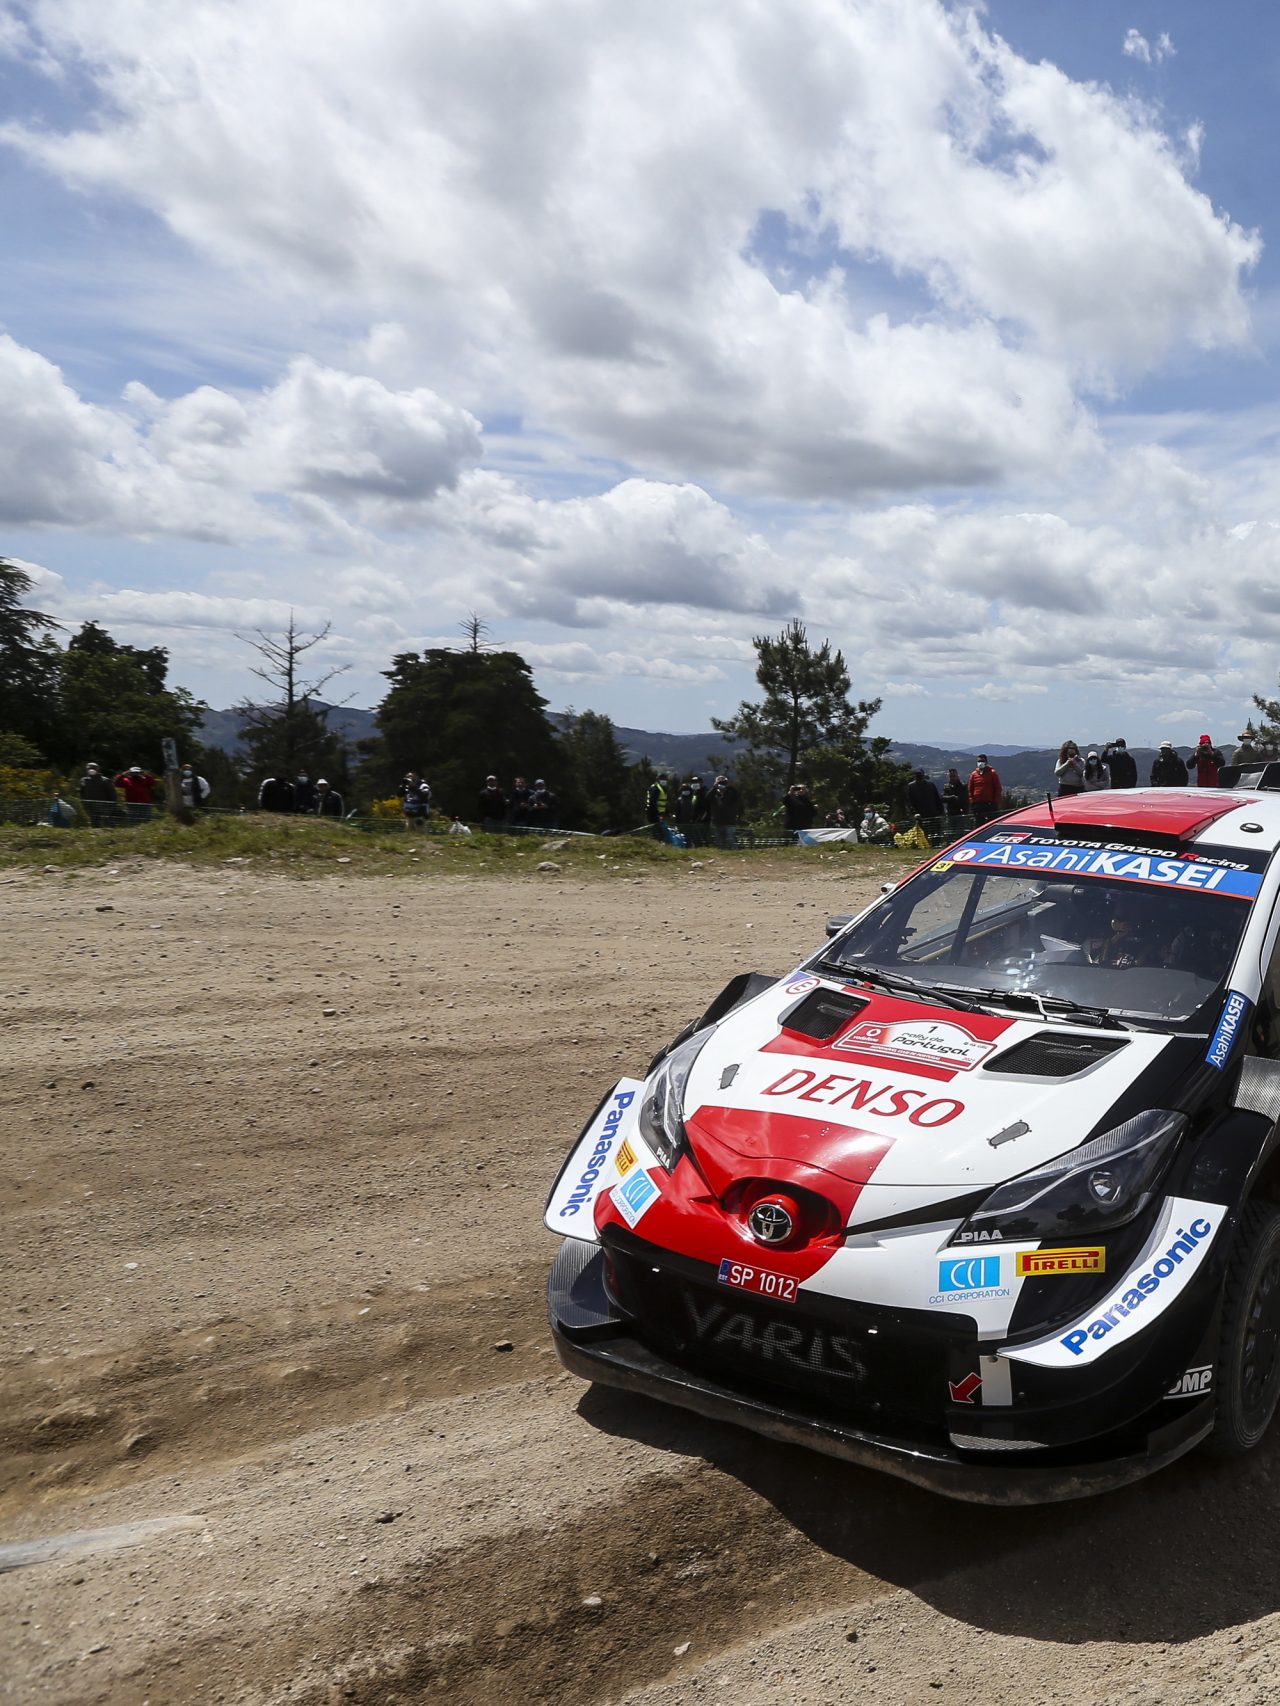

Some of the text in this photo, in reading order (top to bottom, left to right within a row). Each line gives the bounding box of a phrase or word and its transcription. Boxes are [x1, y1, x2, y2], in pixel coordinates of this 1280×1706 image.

[978, 845, 1228, 889] AsahiKASEI
[1029, 837, 1250, 870] TOYOTA GAZOO Racing
[901, 1032, 929, 1041] rally
[928, 1025, 939, 1034] 1
[1210, 995, 1245, 1068] AsahiKASEI
[891, 1036, 970, 1057] Portugal
[760, 1068, 966, 1128] DENSO
[559, 1091, 636, 1217] Panasonic
[656, 1147, 670, 1169] PIAA
[960, 1229, 1004, 1243] PIAA
[950, 1259, 986, 1289] CCI
[1022, 1251, 1100, 1272] PIRELLI
[718, 1273, 728, 1282] EST
[730, 1265, 795, 1299] SP 1012
[1060, 1218, 1211, 1356] Panasonic
[928, 1288, 1010, 1305] CCI CORPORATION
[683, 1291, 868, 1383] YARIS
